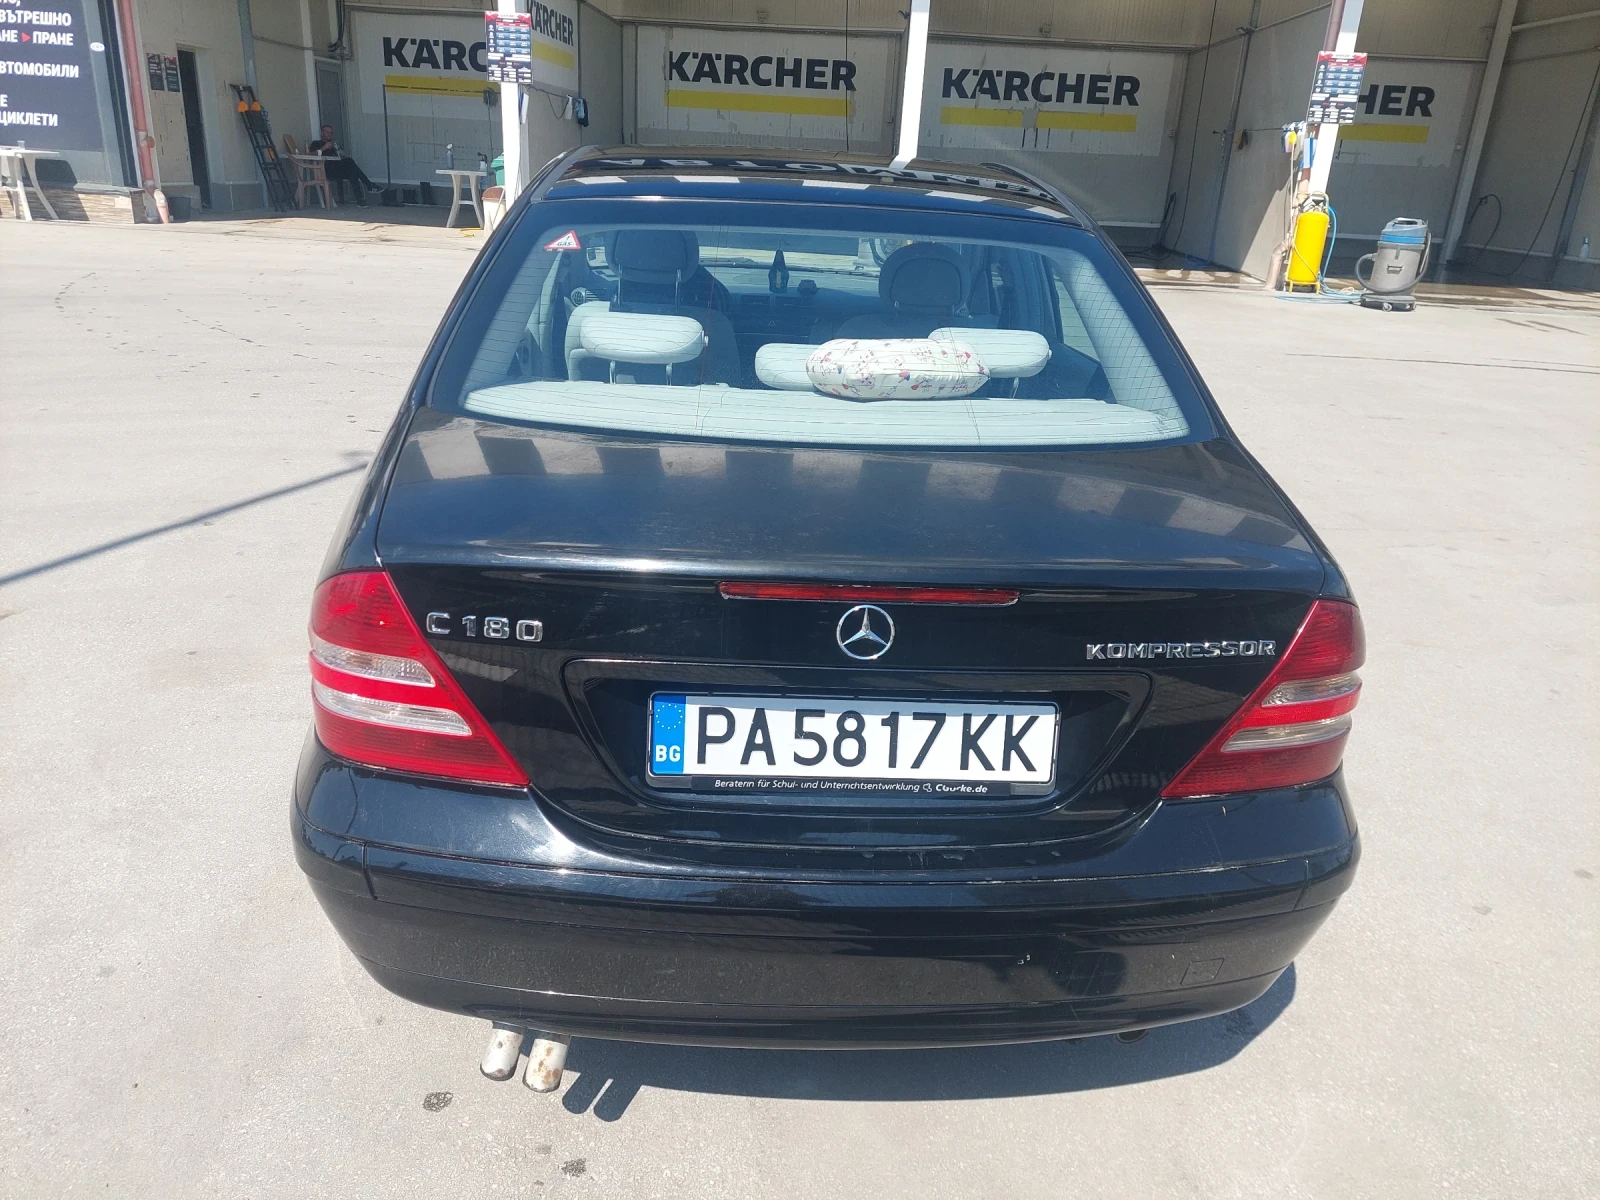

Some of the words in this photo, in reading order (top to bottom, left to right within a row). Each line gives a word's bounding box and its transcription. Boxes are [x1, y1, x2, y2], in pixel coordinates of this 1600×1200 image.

[32, 30, 74, 46] ПРАНЕ
[383, 37, 486, 73] KÄRC
[668, 51, 857, 91] KÄRCHER
[942, 68, 1140, 106] KÄRCHER
[426, 612, 450, 635] C
[461, 615, 544, 642] 180
[1086, 640, 1277, 660] KOMPRESSOR
[655, 744, 681, 762] BG
[757, 779, 771, 788] für
[800, 781, 819, 789] und
